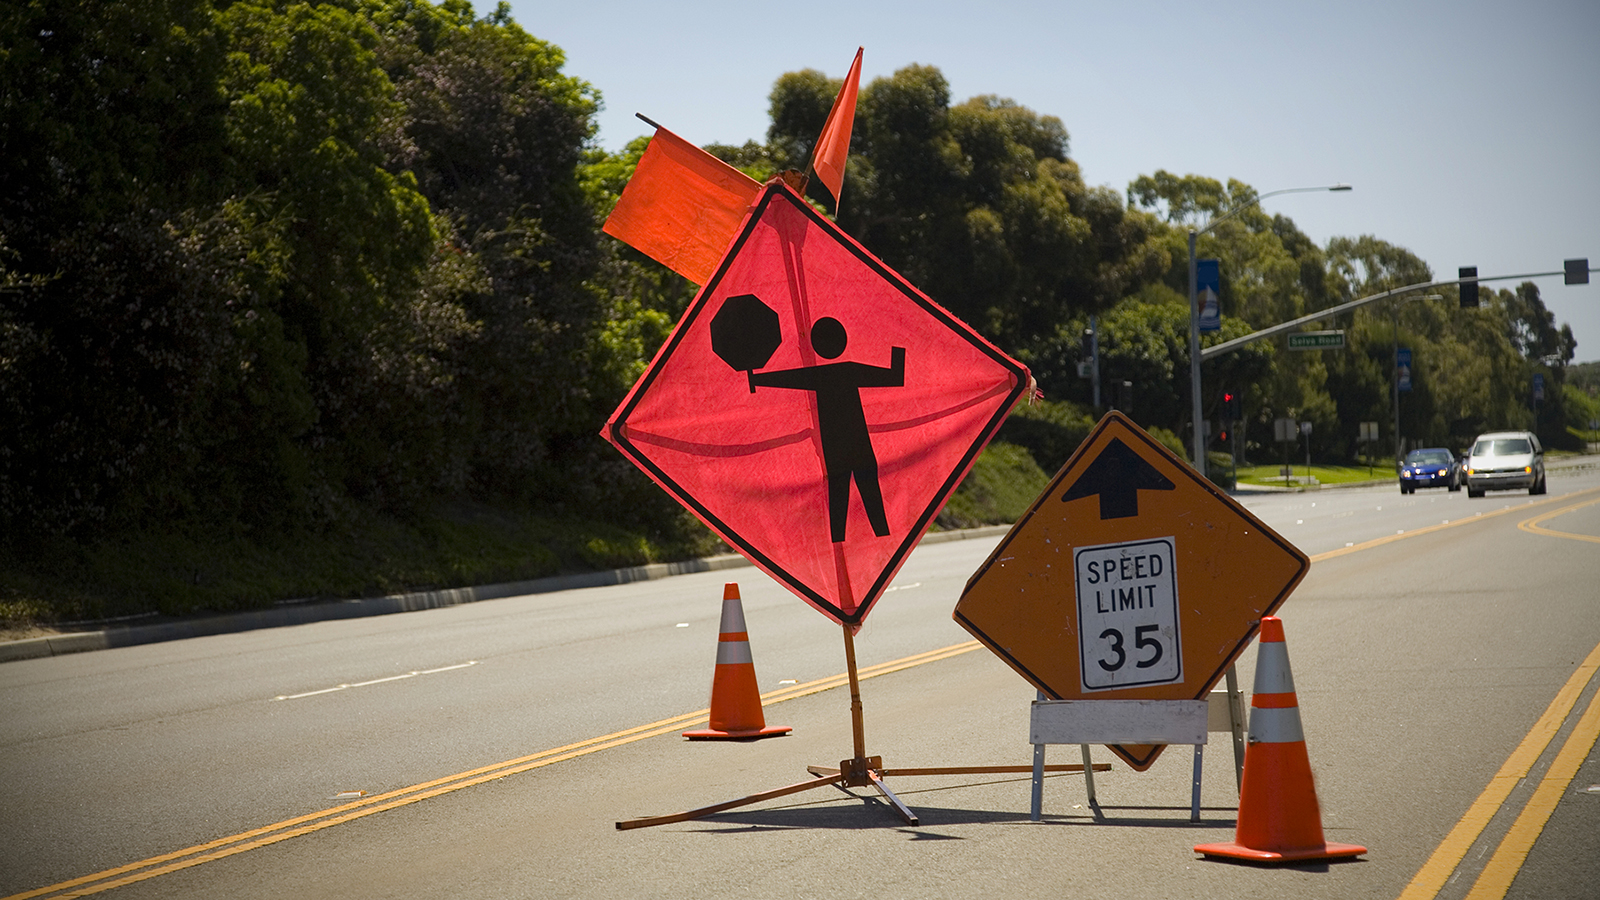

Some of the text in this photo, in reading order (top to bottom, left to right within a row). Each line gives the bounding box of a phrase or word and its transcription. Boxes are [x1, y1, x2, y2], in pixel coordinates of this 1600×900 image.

[1319, 335, 1341, 345] Road
[1087, 554, 1163, 584] SPEED
[1096, 584, 1157, 614] LIMIT
[1098, 624, 1163, 671] 35
